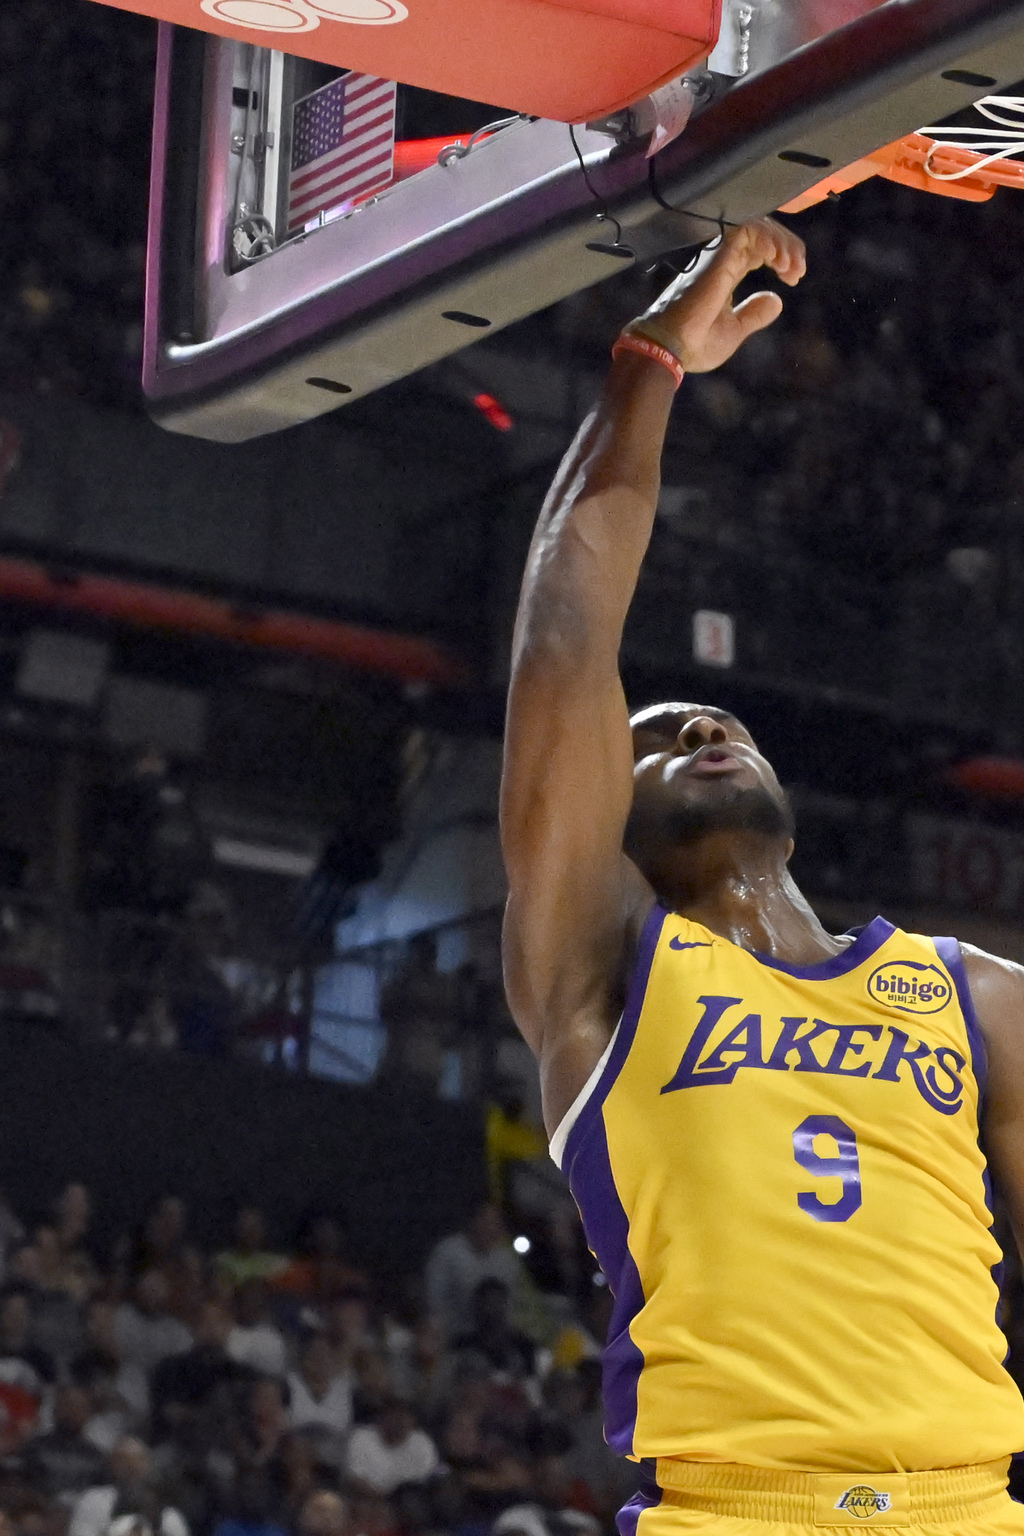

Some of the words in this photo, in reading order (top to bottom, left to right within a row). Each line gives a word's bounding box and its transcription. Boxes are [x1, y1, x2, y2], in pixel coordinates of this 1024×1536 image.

[876, 975, 947, 1002] bibigo
[887, 994, 918, 1005] 비비고
[660, 995, 967, 1115] LAKERS
[792, 1115, 862, 1222] 9
[837, 1491, 891, 1511] LAKERS
